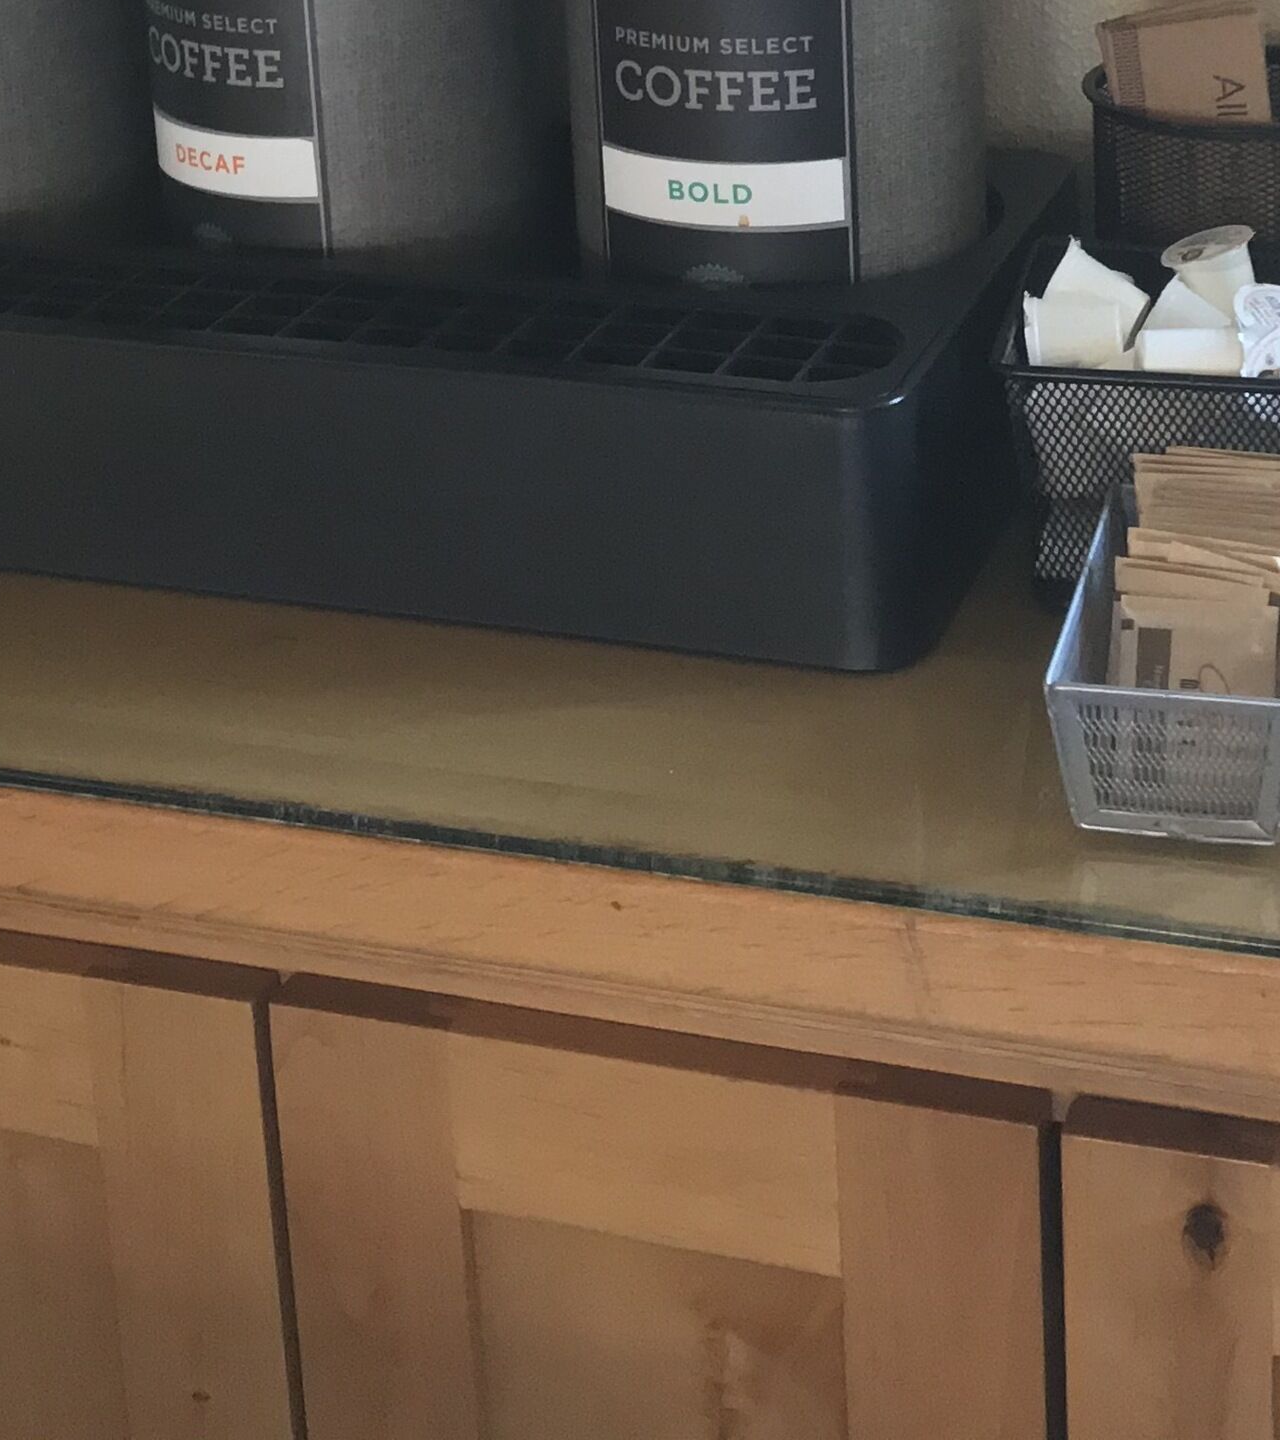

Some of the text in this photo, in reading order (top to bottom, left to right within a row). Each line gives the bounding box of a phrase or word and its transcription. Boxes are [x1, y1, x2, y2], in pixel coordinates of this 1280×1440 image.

[202, 13, 278, 35] SELECT
[615, 26, 814, 56] PREMIUM SELECT
[148, 25, 284, 89] COFFEE
[615, 59, 818, 112] COFFEE
[175, 143, 246, 175] DECAF
[667, 179, 753, 205] BOLD
